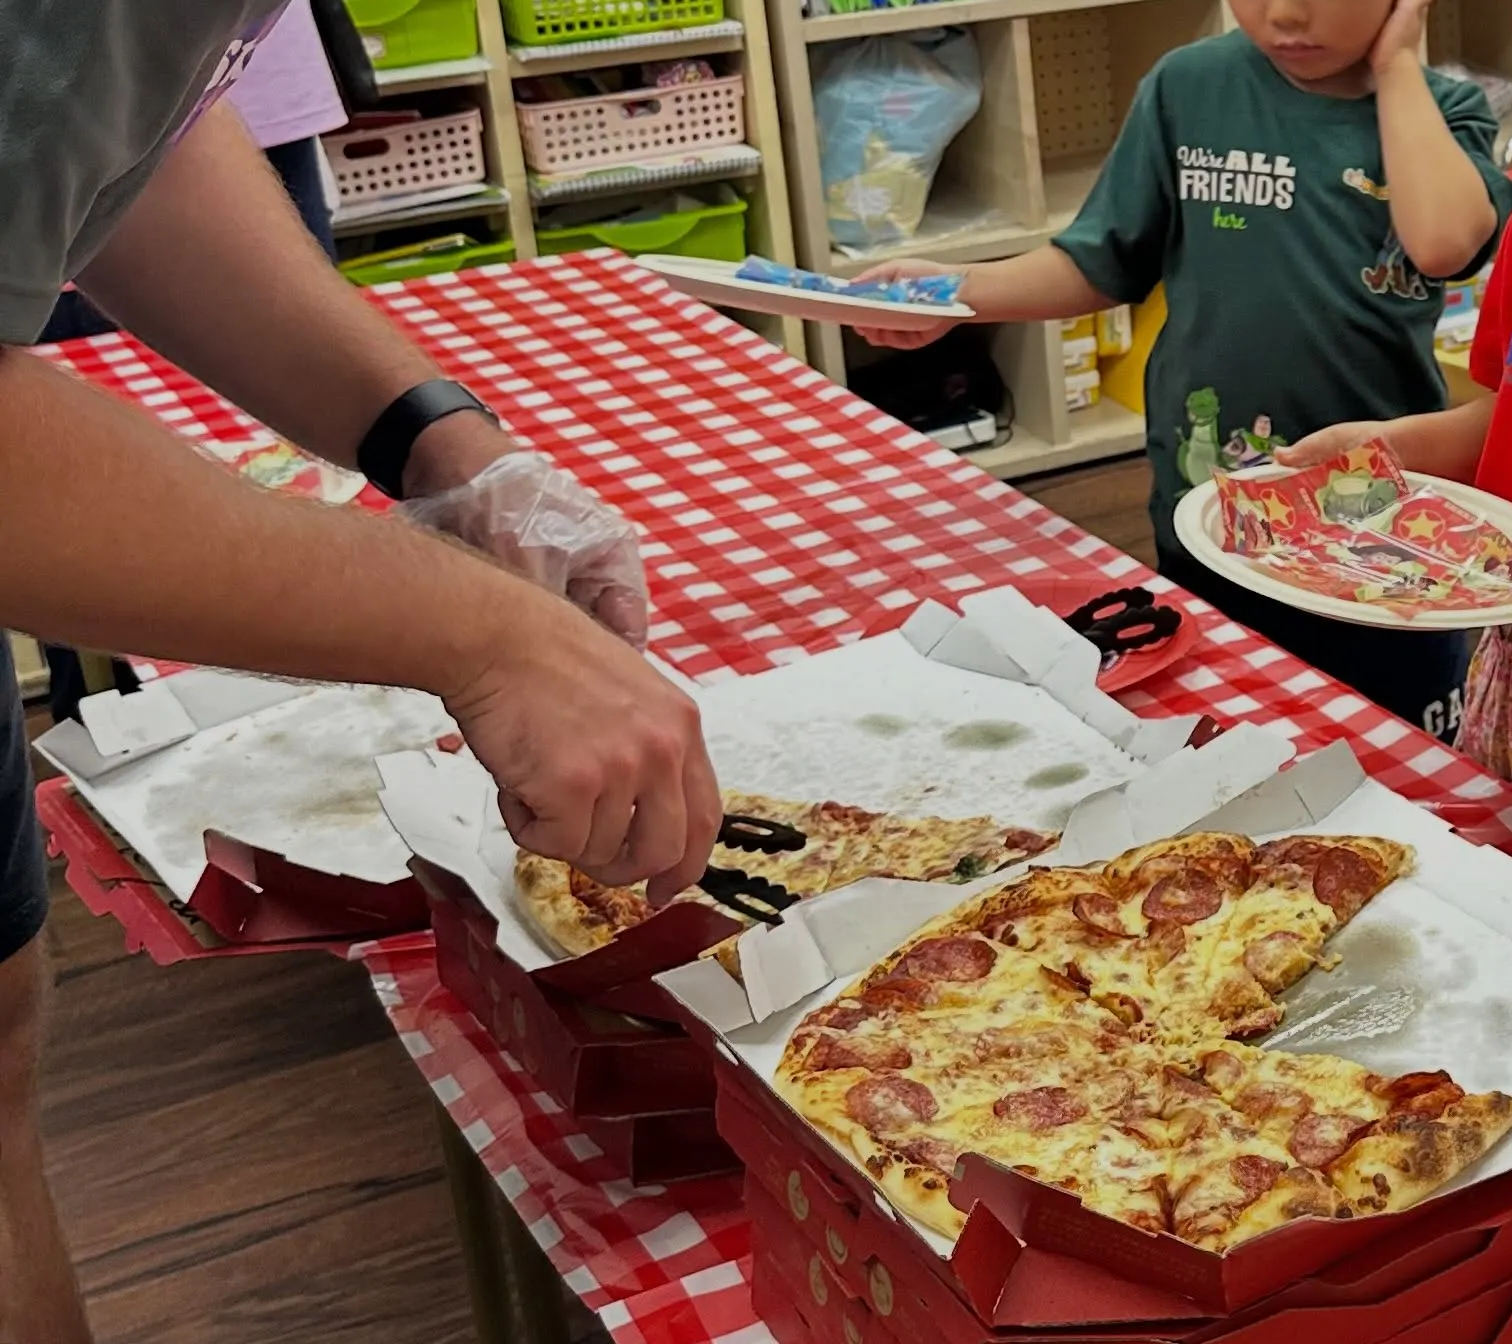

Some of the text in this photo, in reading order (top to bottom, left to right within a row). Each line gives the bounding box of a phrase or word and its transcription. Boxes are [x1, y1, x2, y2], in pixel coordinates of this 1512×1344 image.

[1225, 149, 1297, 178] ALL
[1178, 169, 1297, 211] FRIENDS
[1213, 206, 1248, 231] here
